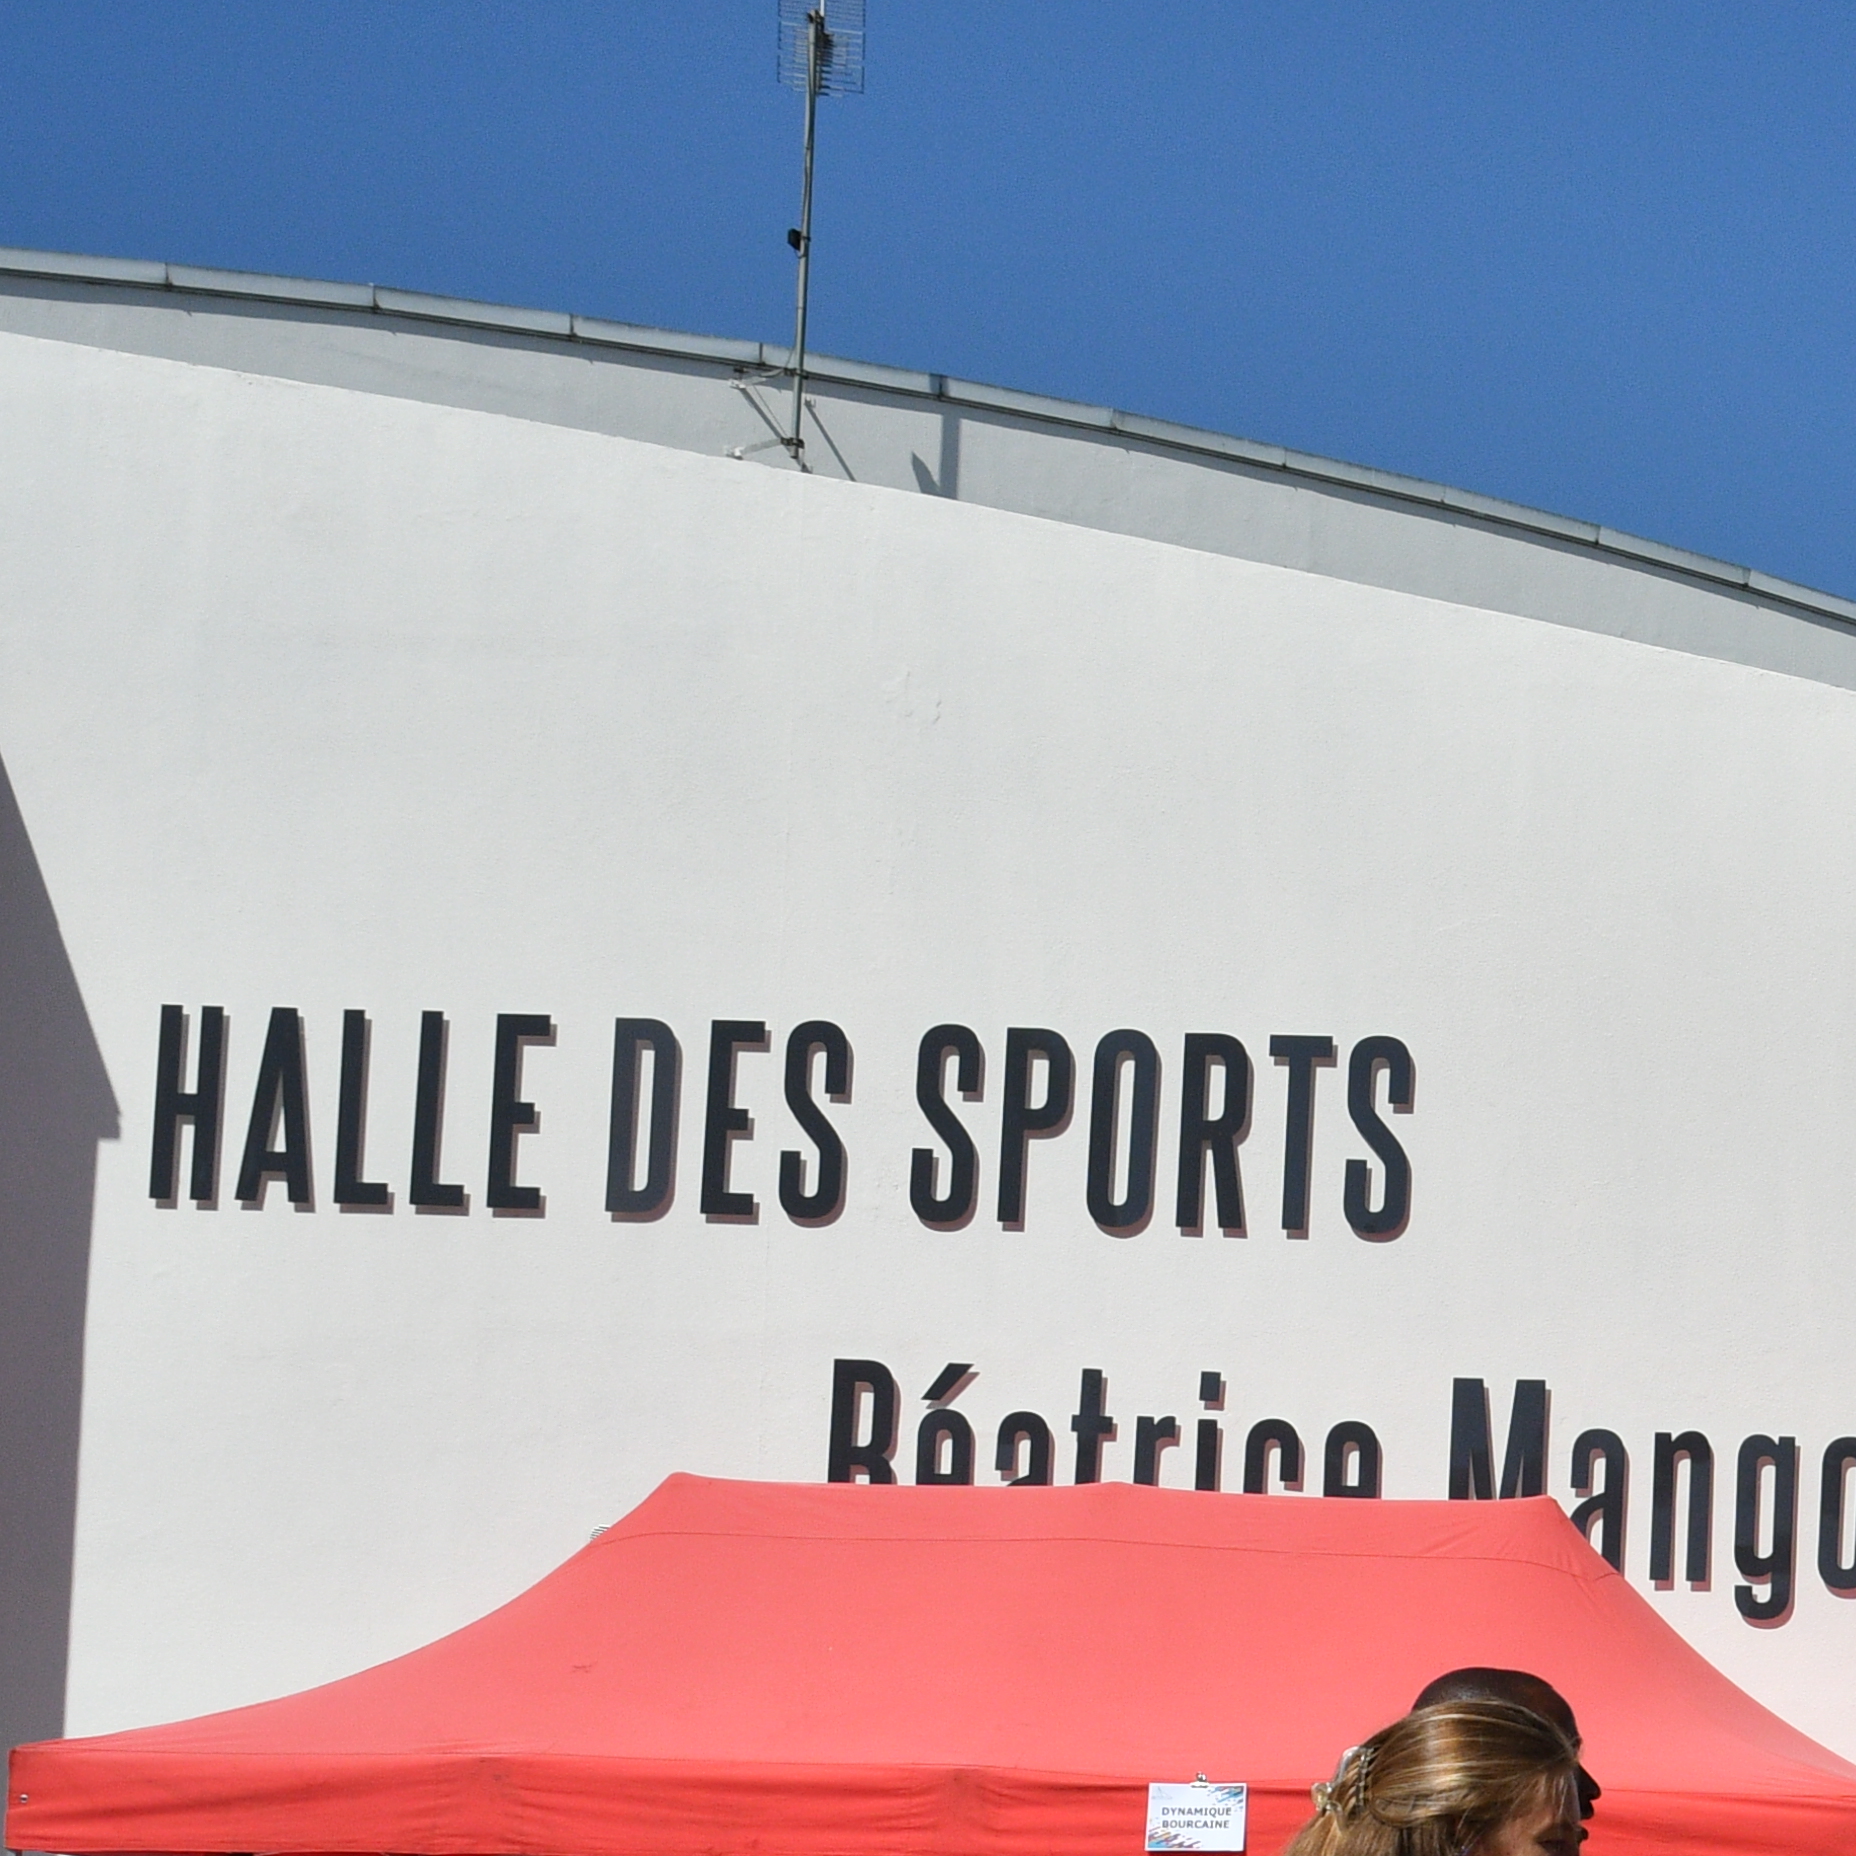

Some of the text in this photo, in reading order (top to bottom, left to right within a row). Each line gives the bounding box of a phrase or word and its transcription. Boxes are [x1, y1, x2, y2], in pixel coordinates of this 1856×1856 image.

[149, 1005, 1415, 1234] HALLE DES SPORTS
[1161, 1807, 1232, 1818] DYNAMIQUE
[1161, 1820, 1230, 1829] BOURCAINE
